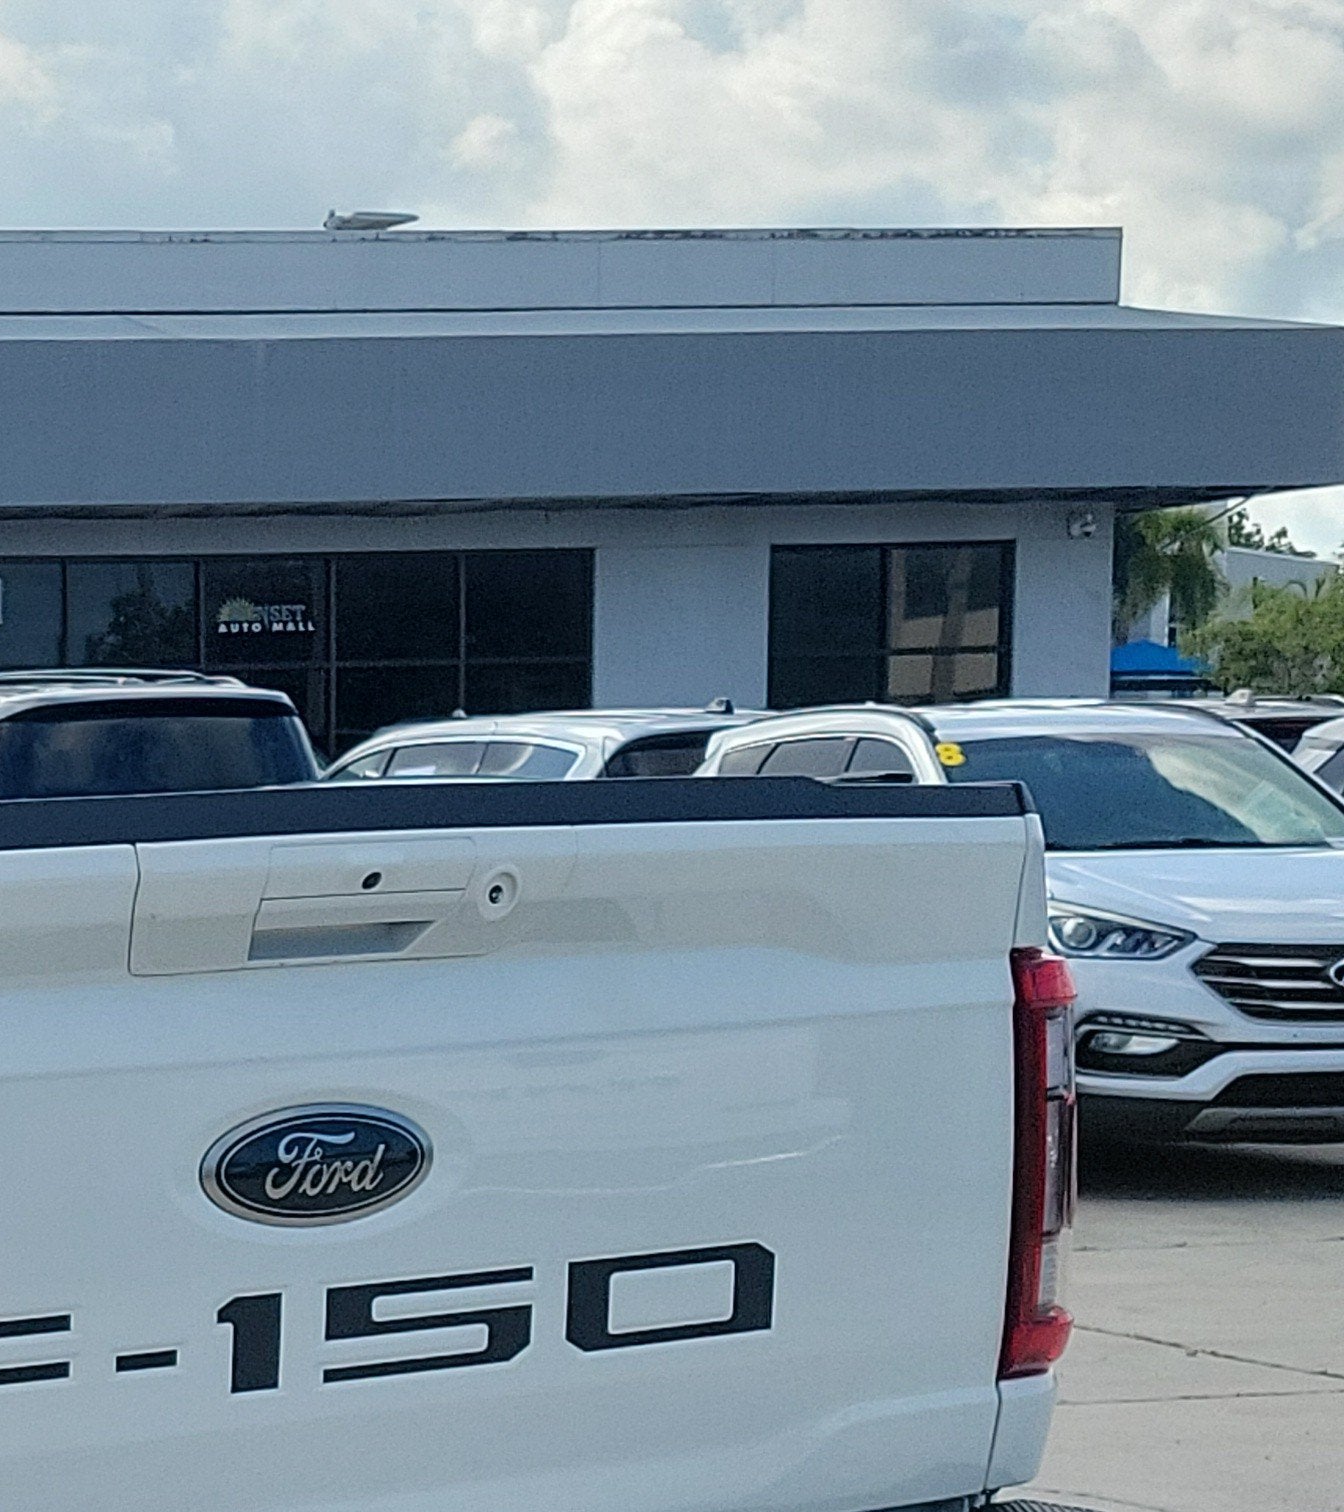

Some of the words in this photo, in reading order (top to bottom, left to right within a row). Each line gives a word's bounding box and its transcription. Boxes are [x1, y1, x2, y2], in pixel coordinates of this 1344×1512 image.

[218, 622, 262, 634] AUTO
[272, 620, 316, 633] MALL
[264, 1130, 386, 1200] Ford
